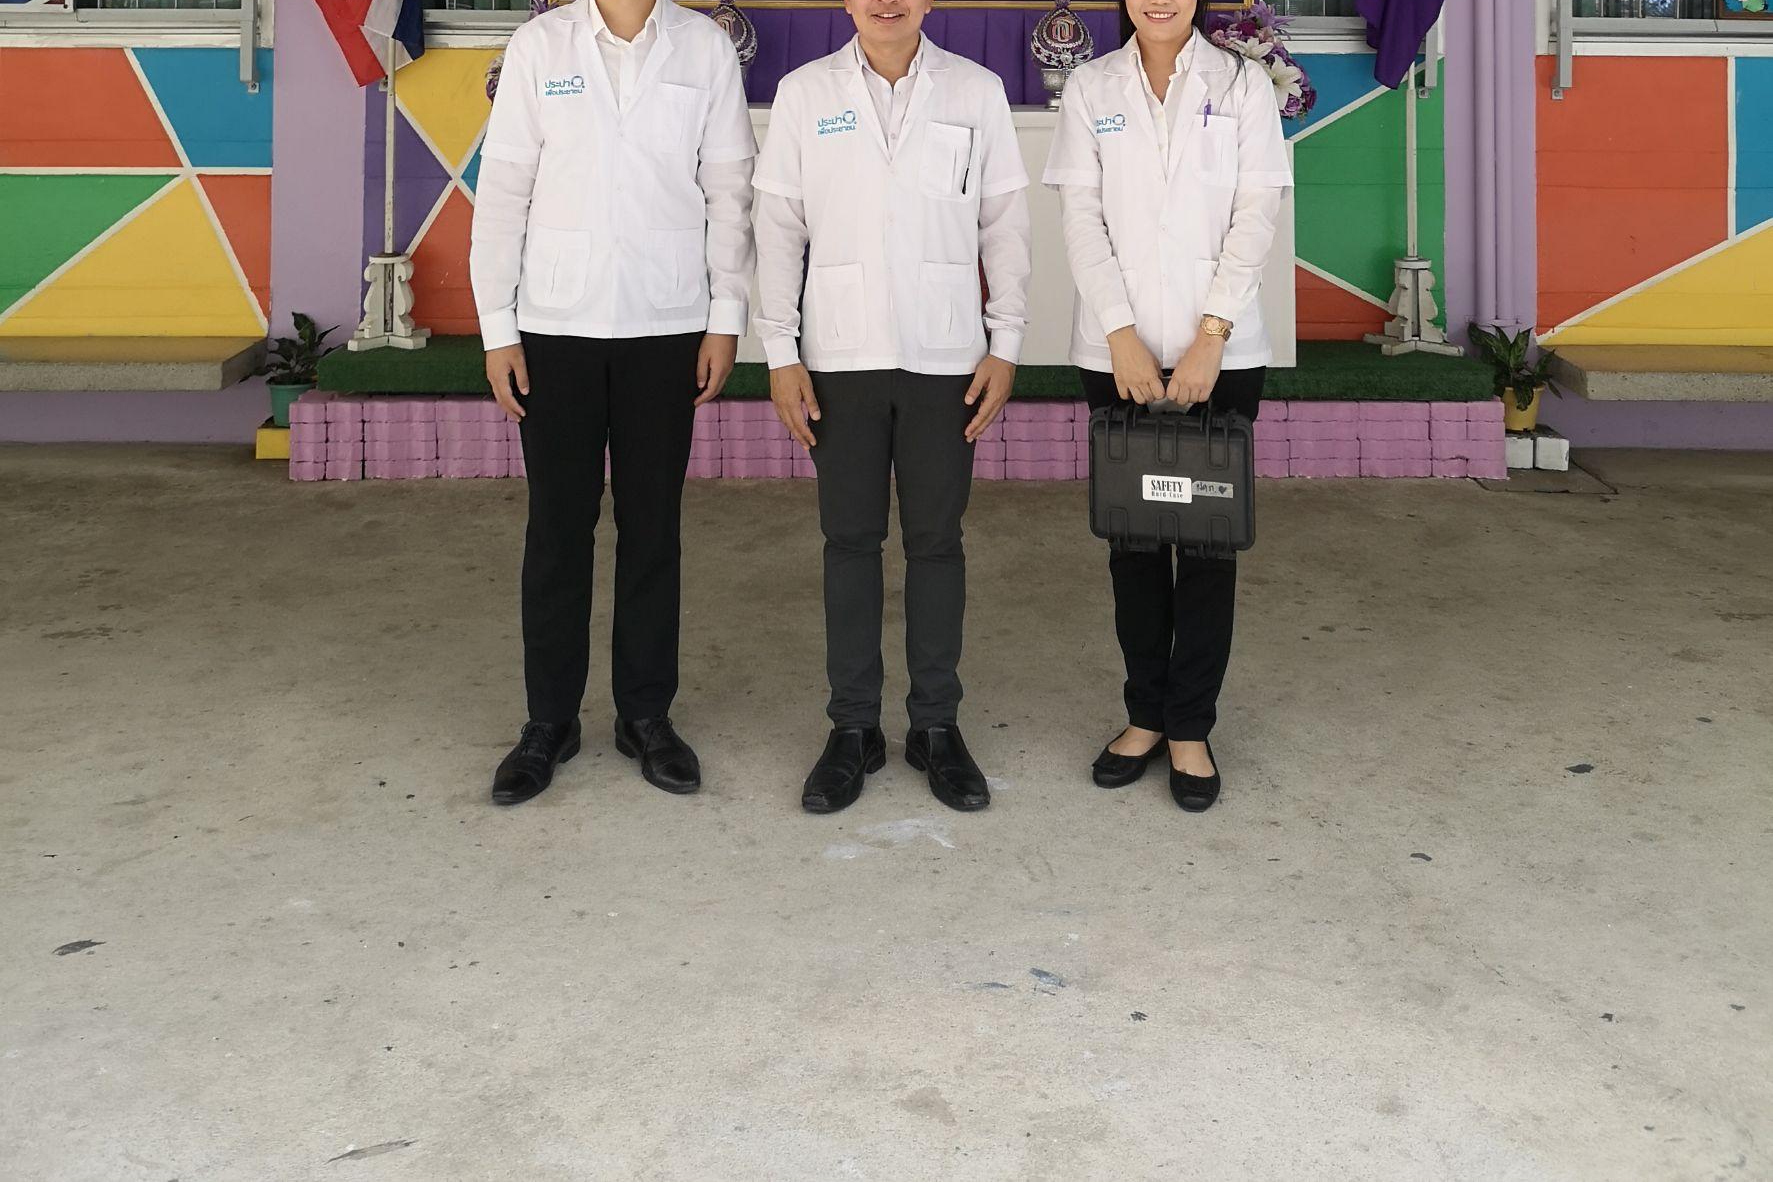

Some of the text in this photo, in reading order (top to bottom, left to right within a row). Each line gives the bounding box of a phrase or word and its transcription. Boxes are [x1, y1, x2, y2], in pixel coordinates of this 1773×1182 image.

[544, 79, 571, 89] ประปา
[817, 116, 843, 128] ประปา
[1151, 479, 1184, 493] SAFETY
